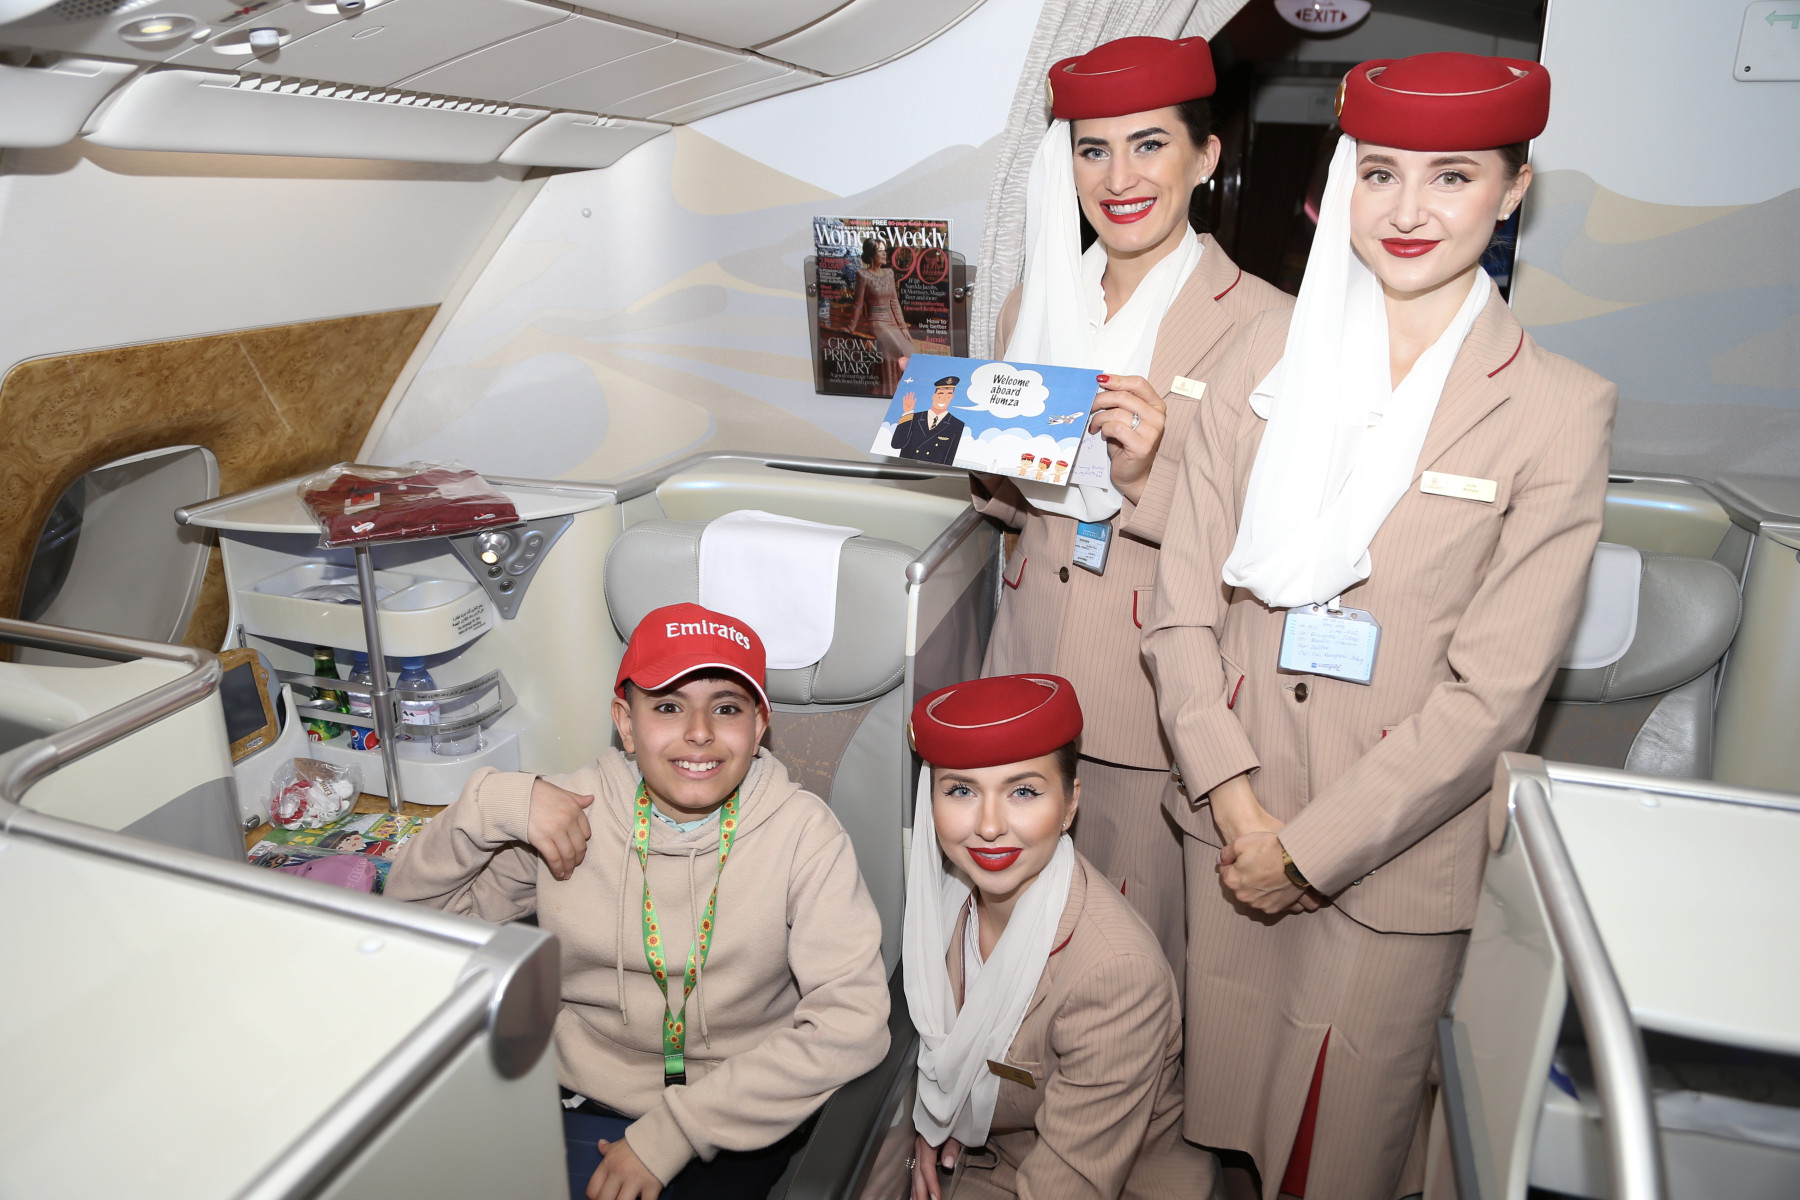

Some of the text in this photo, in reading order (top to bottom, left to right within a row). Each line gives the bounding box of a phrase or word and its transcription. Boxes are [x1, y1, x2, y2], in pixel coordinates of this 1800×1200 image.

[1302, 8, 1340, 23] EXIT
[815, 224, 947, 249] Women's Weekly
[892, 247, 949, 285] 90
[828, 337, 878, 351] CROWN
[824, 348, 884, 363] PRINCESS
[836, 361, 872, 374] MARY
[993, 374, 1030, 387] Welcome
[990, 385, 1022, 396] aboard
[990, 394, 1020, 407] Humza
[665, 620, 751, 650] Emirates
